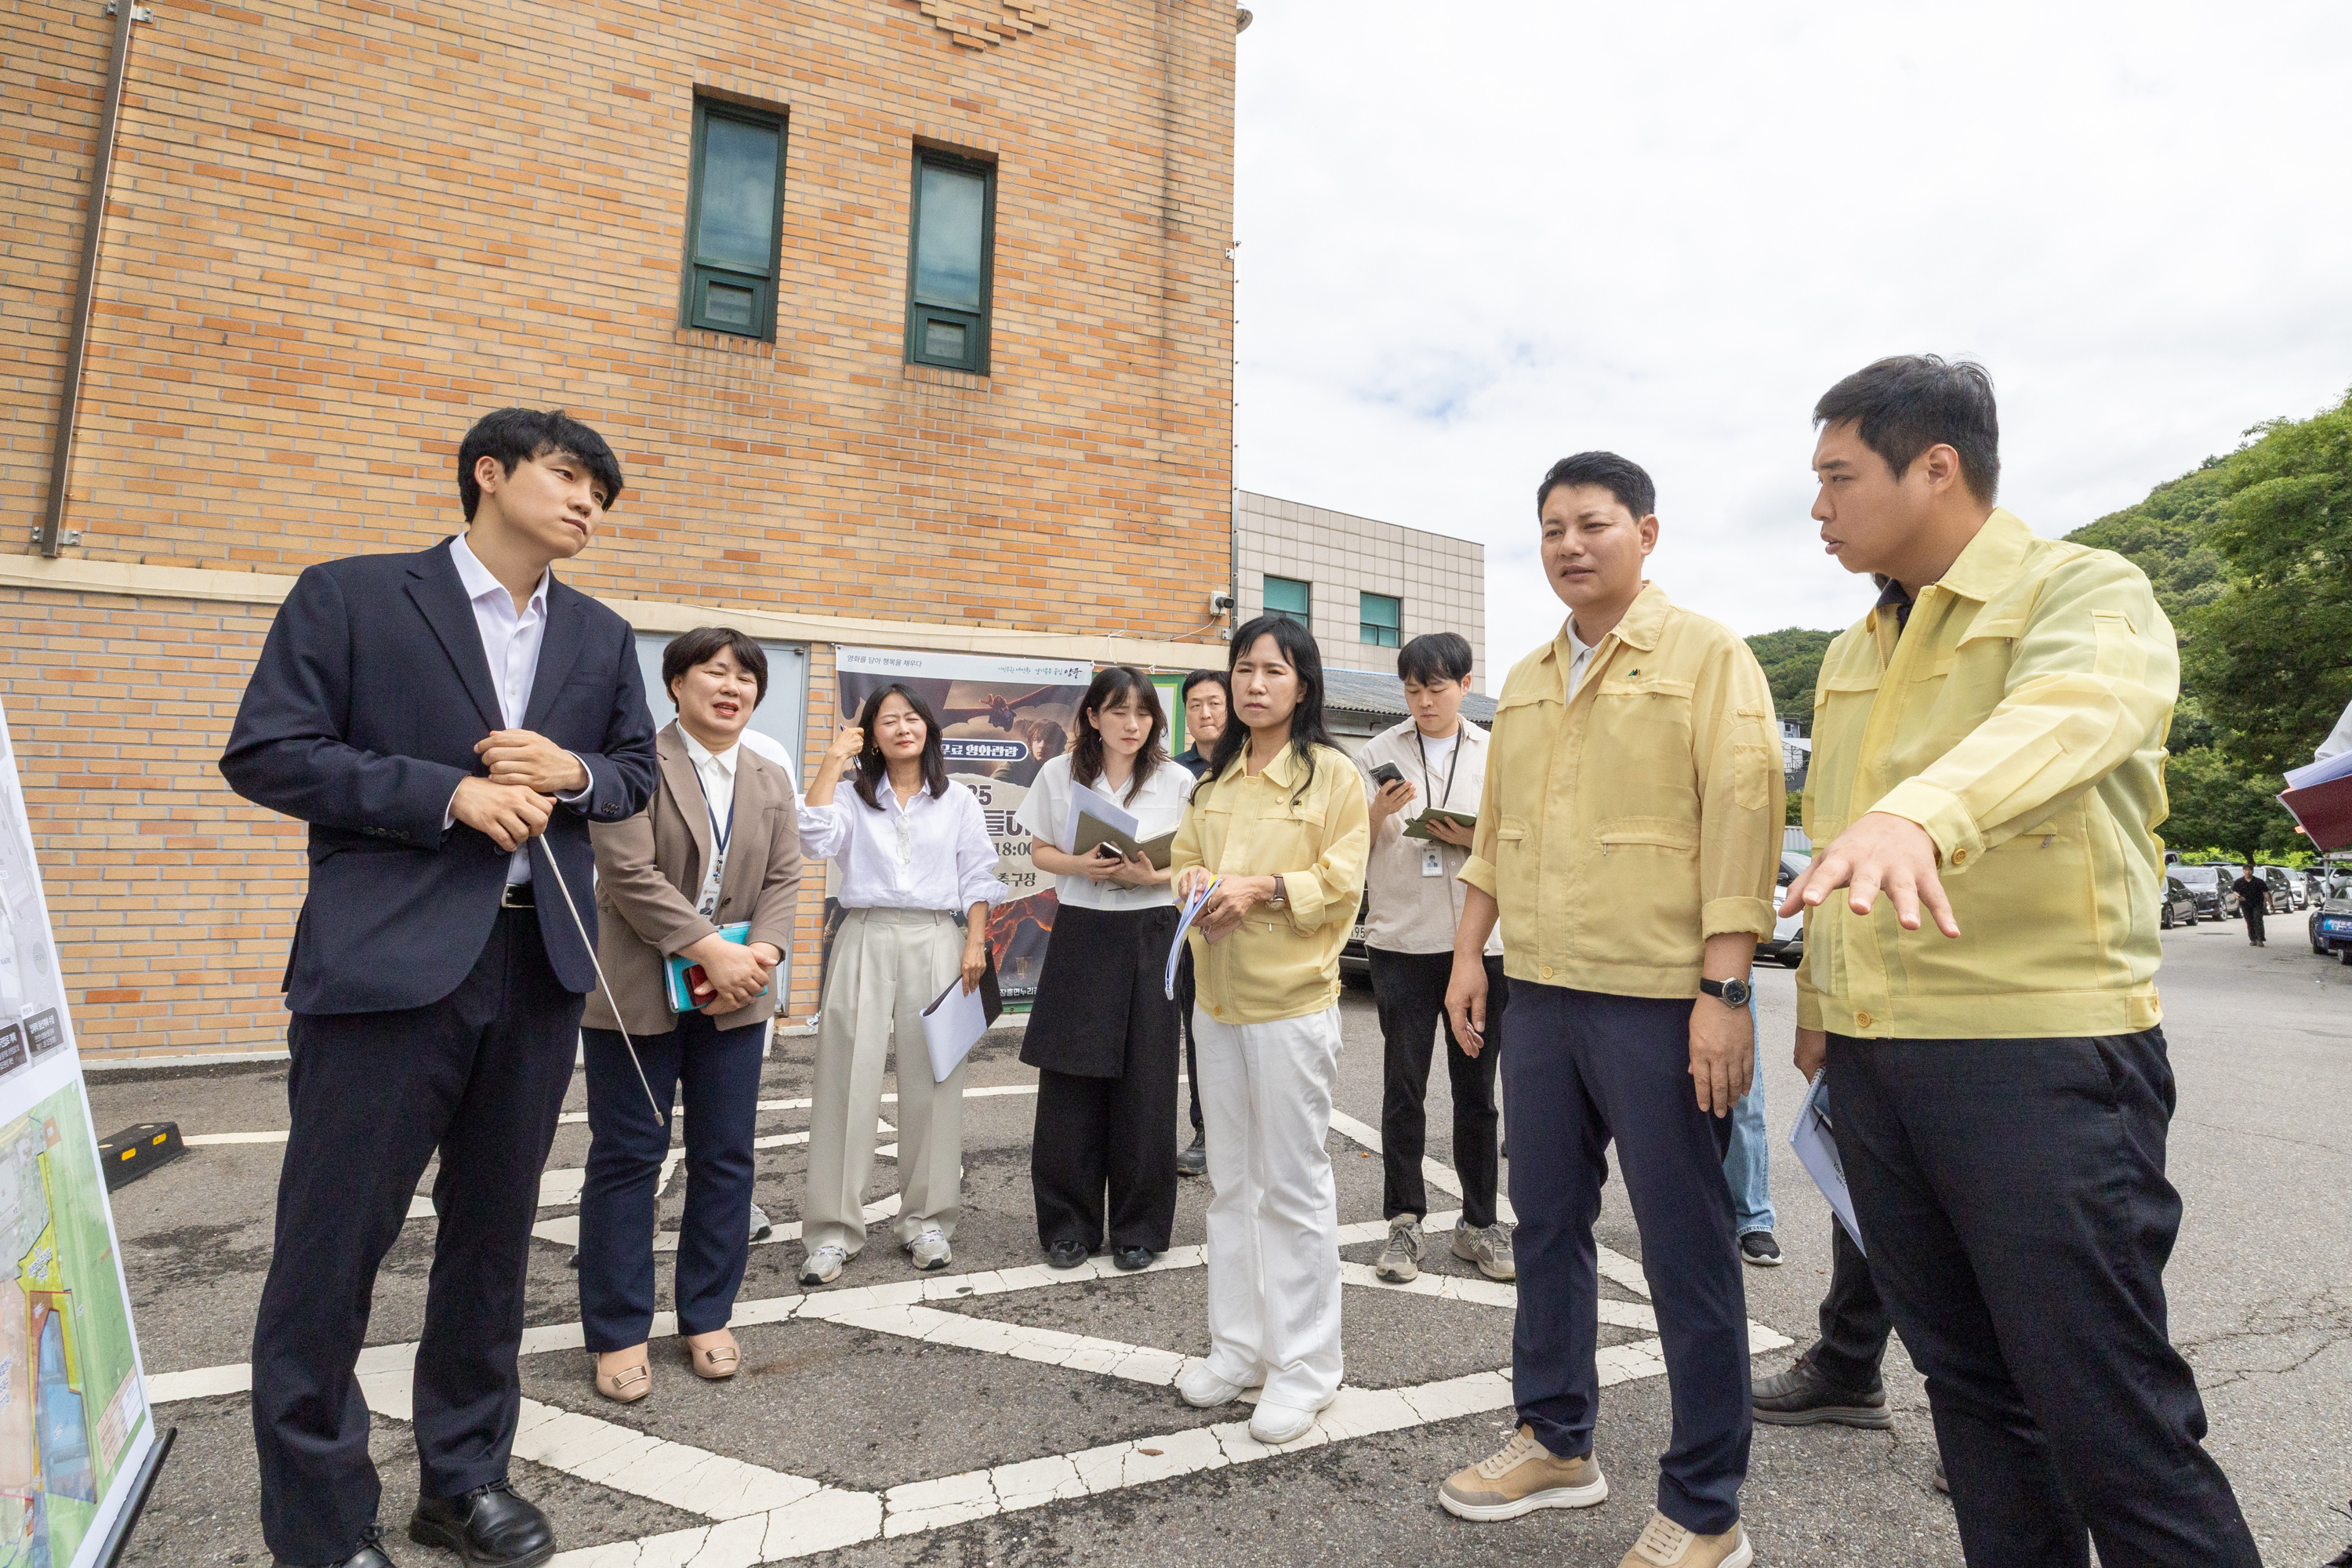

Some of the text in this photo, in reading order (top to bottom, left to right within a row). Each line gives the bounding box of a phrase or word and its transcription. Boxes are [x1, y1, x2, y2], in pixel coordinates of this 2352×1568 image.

[847, 655, 922, 668] 영화를 담아 행복을 채우다
[965, 744, 1018, 757] 영화관람
